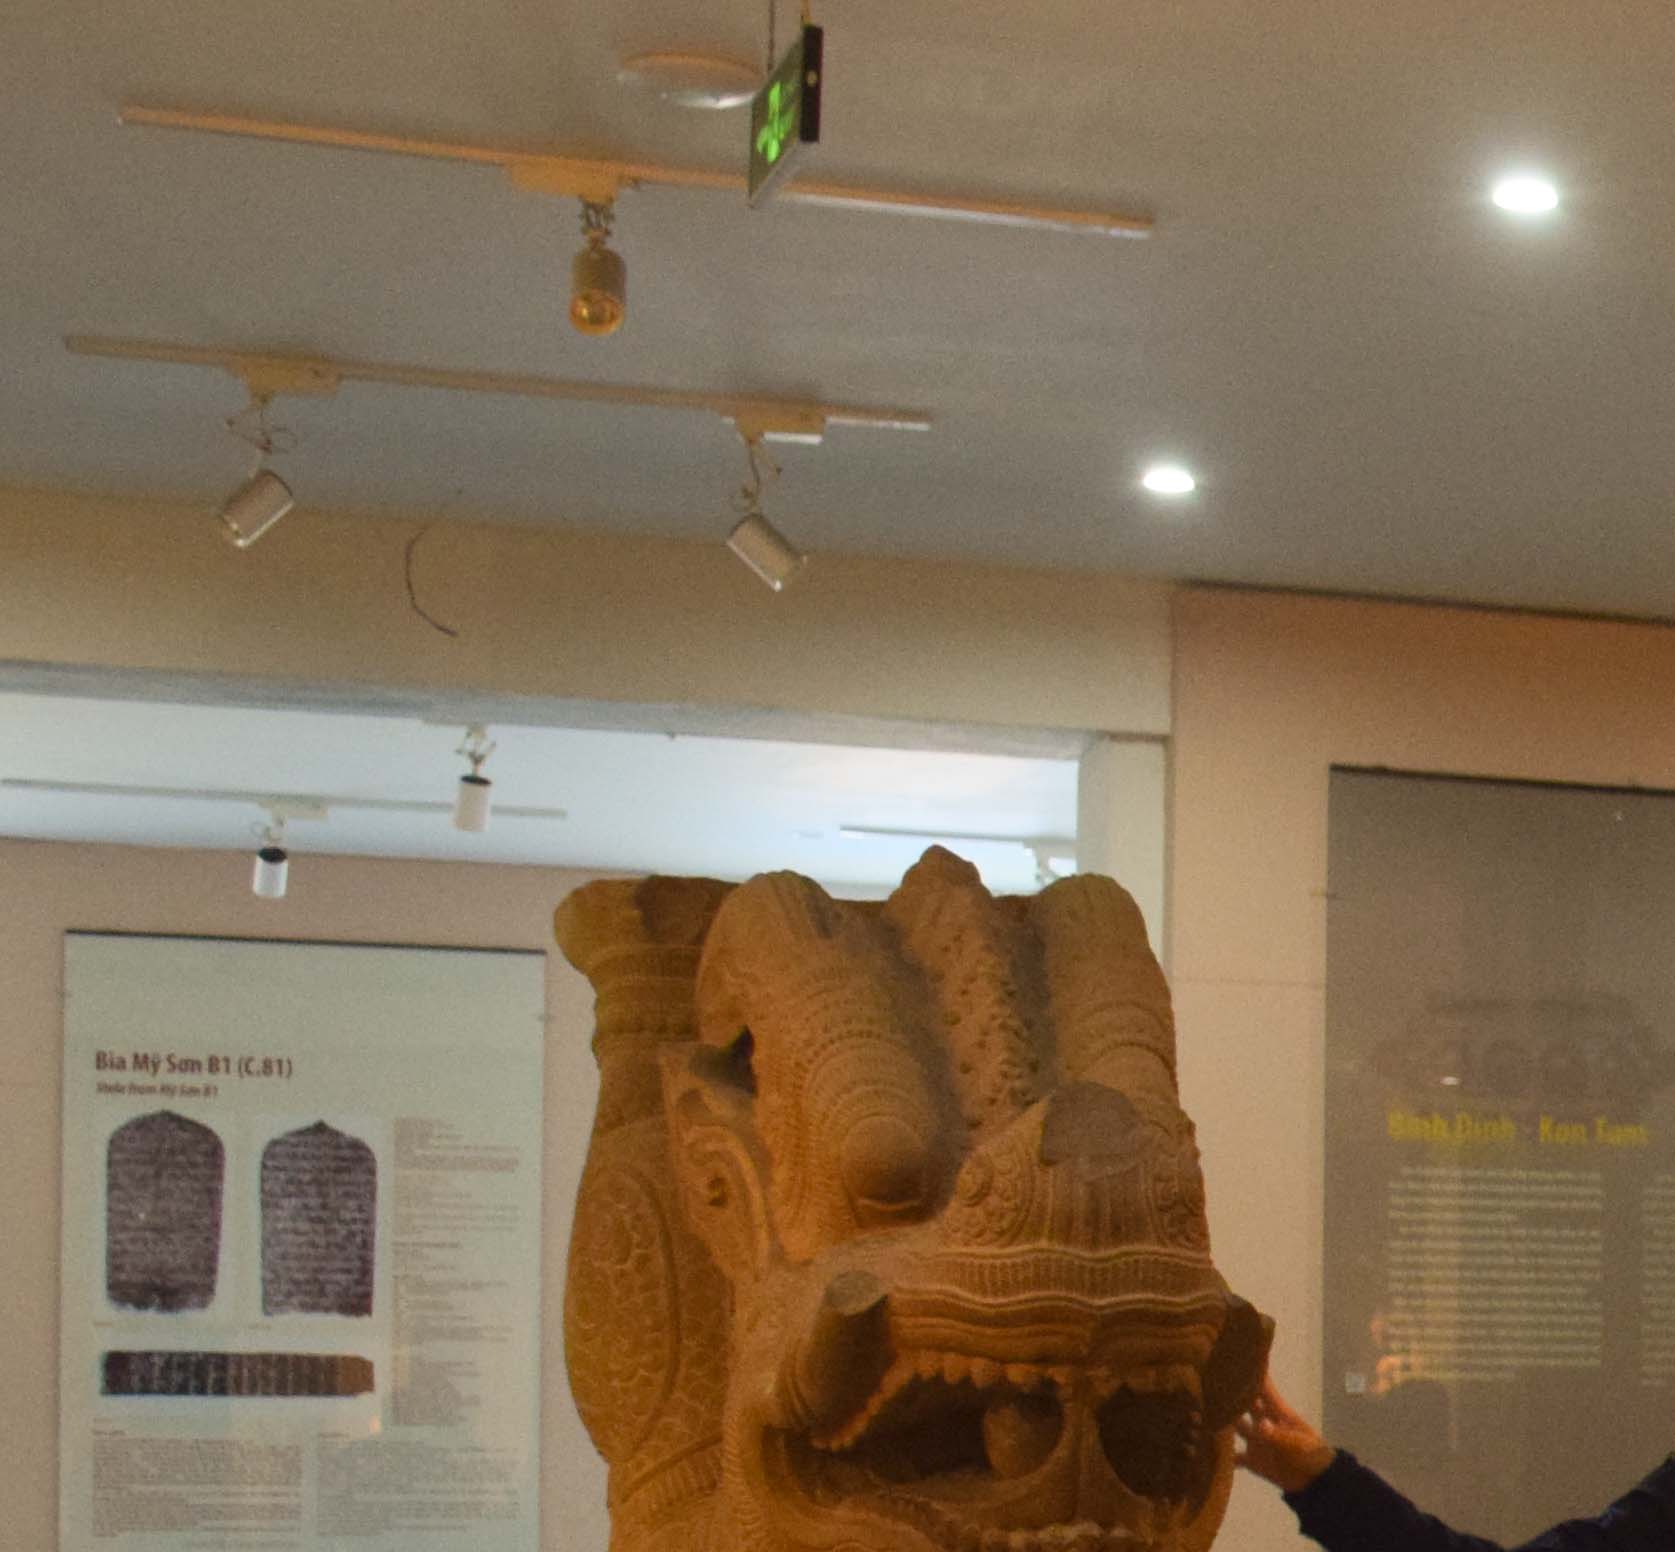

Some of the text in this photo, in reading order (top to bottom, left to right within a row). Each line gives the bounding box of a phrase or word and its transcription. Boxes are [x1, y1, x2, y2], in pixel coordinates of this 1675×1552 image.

[95, 1051, 126, 1071] Bia
[166, 1053, 203, 1074] Sơn
[208, 1055, 230, 1074] B1
